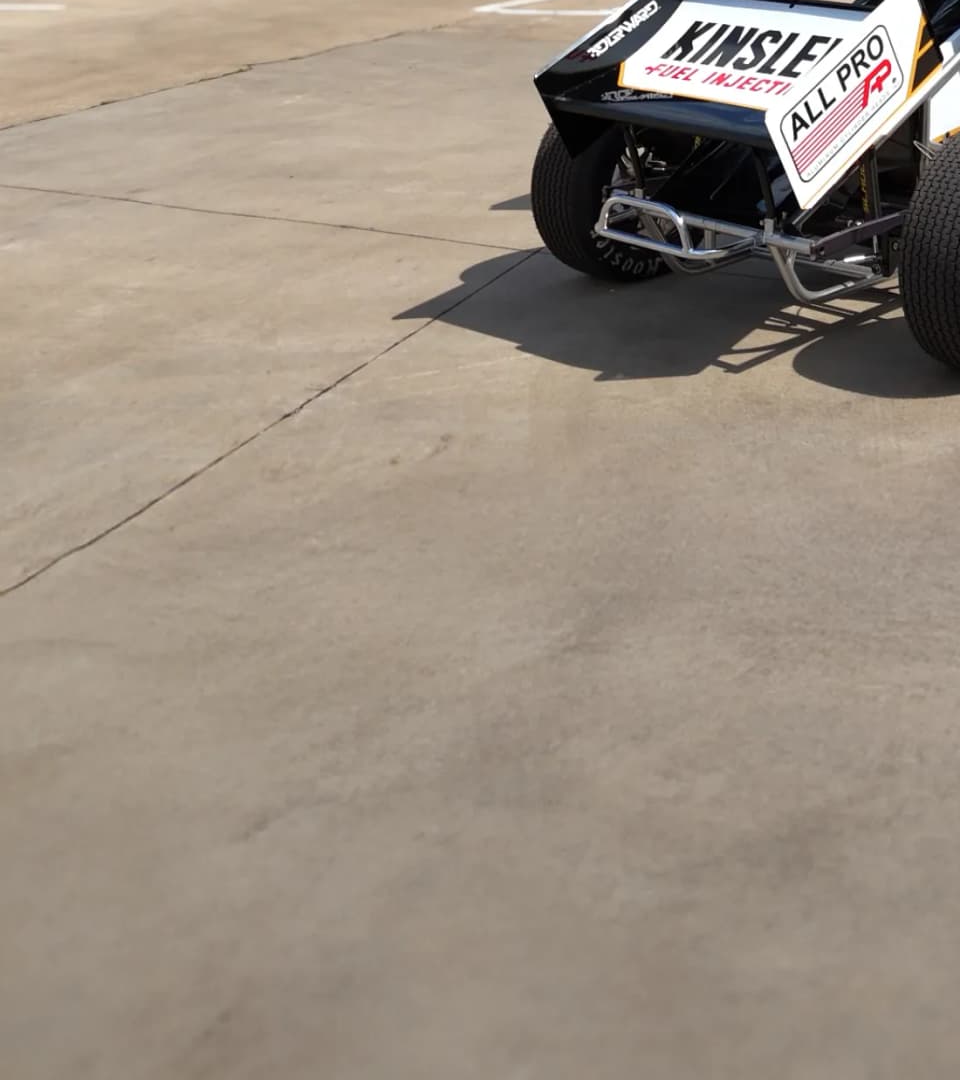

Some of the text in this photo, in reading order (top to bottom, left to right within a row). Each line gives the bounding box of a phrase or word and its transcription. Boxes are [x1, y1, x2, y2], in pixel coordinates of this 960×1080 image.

[645, 63, 793, 96] FUEL INJECTI
[791, 34, 884, 142] ALL PRO
